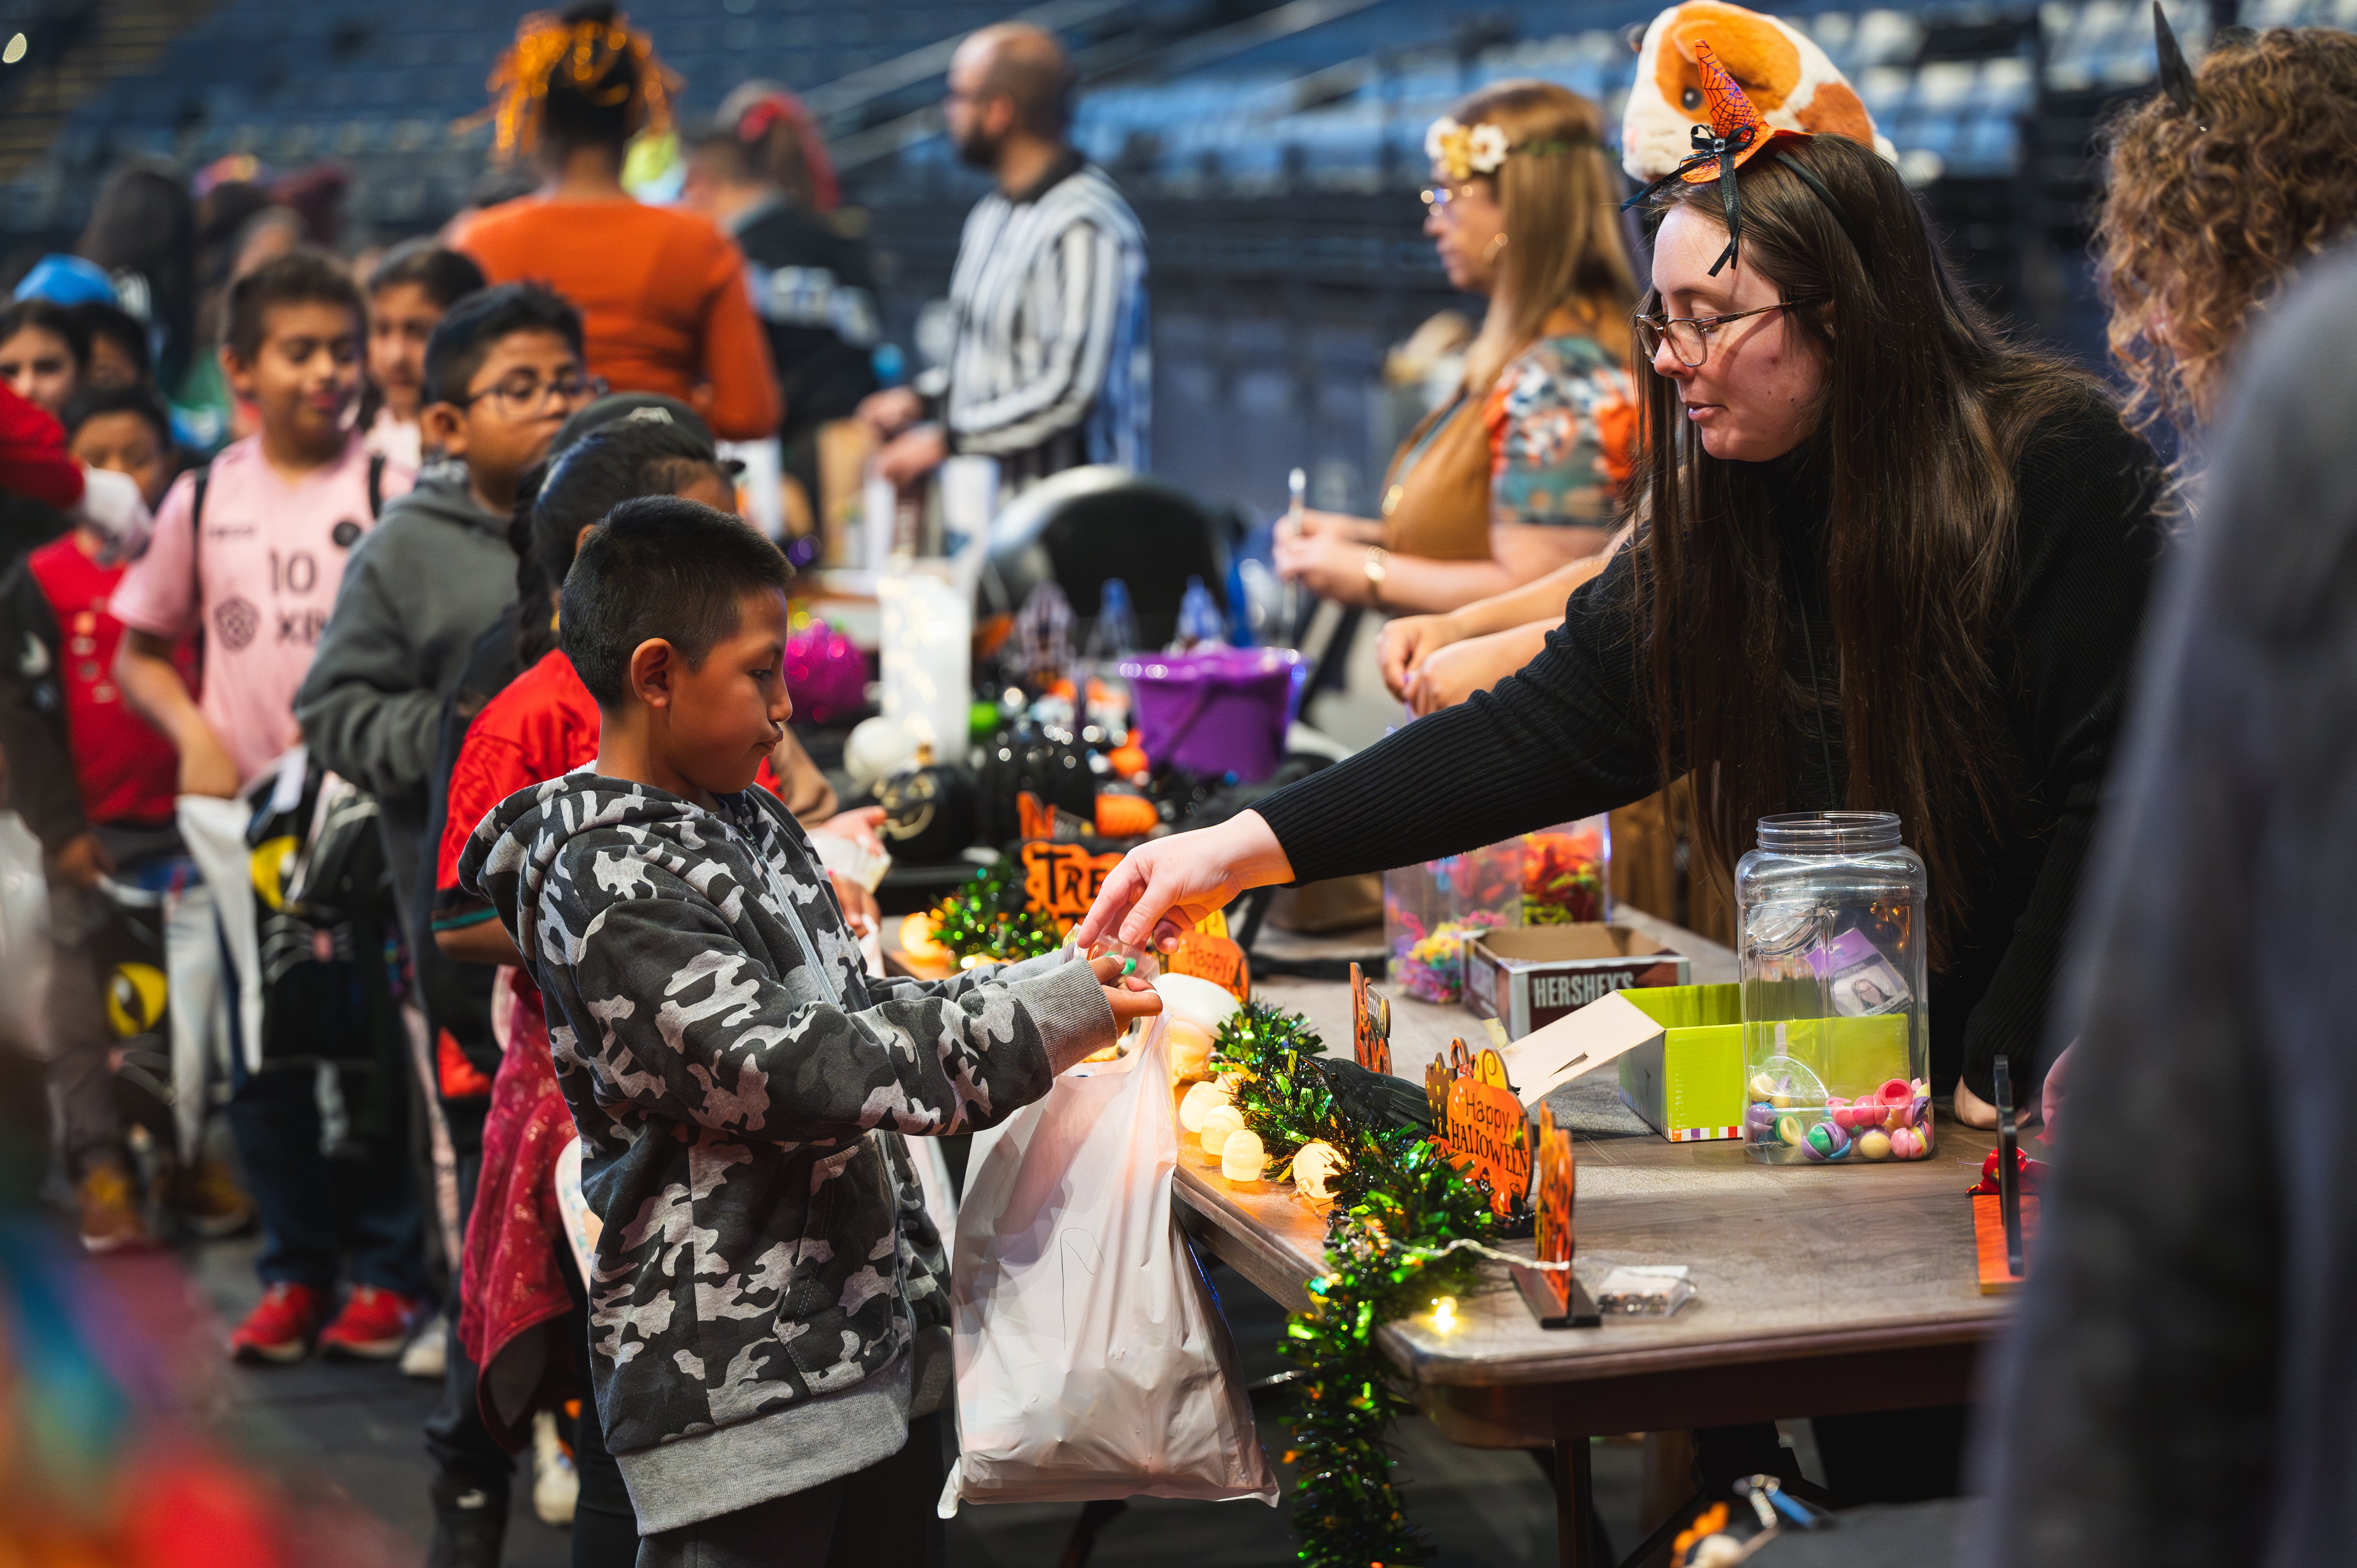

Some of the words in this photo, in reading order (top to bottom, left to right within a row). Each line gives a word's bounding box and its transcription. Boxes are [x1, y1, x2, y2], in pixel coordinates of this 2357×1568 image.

[268, 549, 317, 596] 10
[1033, 851, 1108, 908] TRE
[1466, 1088, 1510, 1139] Happy
[1450, 1117, 1528, 1178] HALLOWEEN
